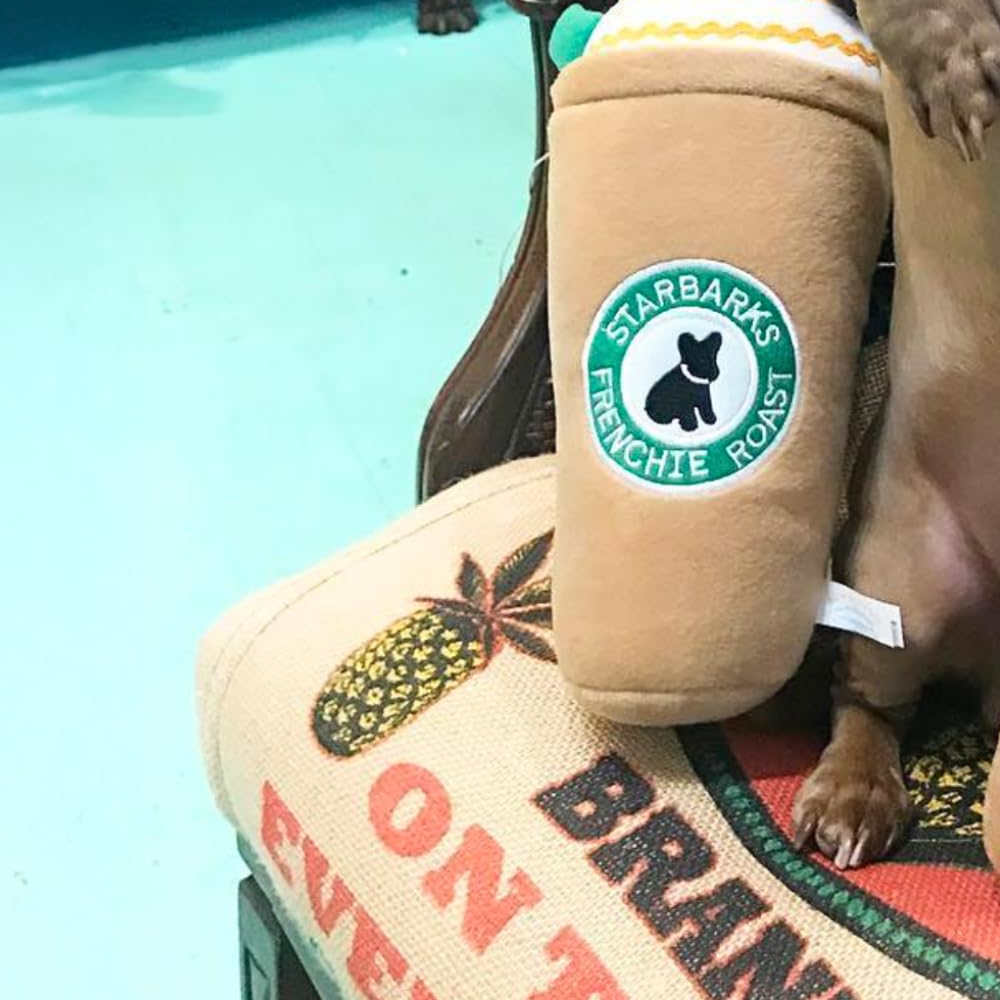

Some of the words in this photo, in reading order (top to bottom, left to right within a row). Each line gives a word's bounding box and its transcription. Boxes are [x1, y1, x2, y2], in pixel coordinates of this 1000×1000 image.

[603, 274, 781, 347] STARBARKS
[590, 366, 710, 479] FRENCHIE
[725, 366, 793, 469] ROAST
[367, 762, 545, 956] ON
[529, 751, 863, 999] BRAN
